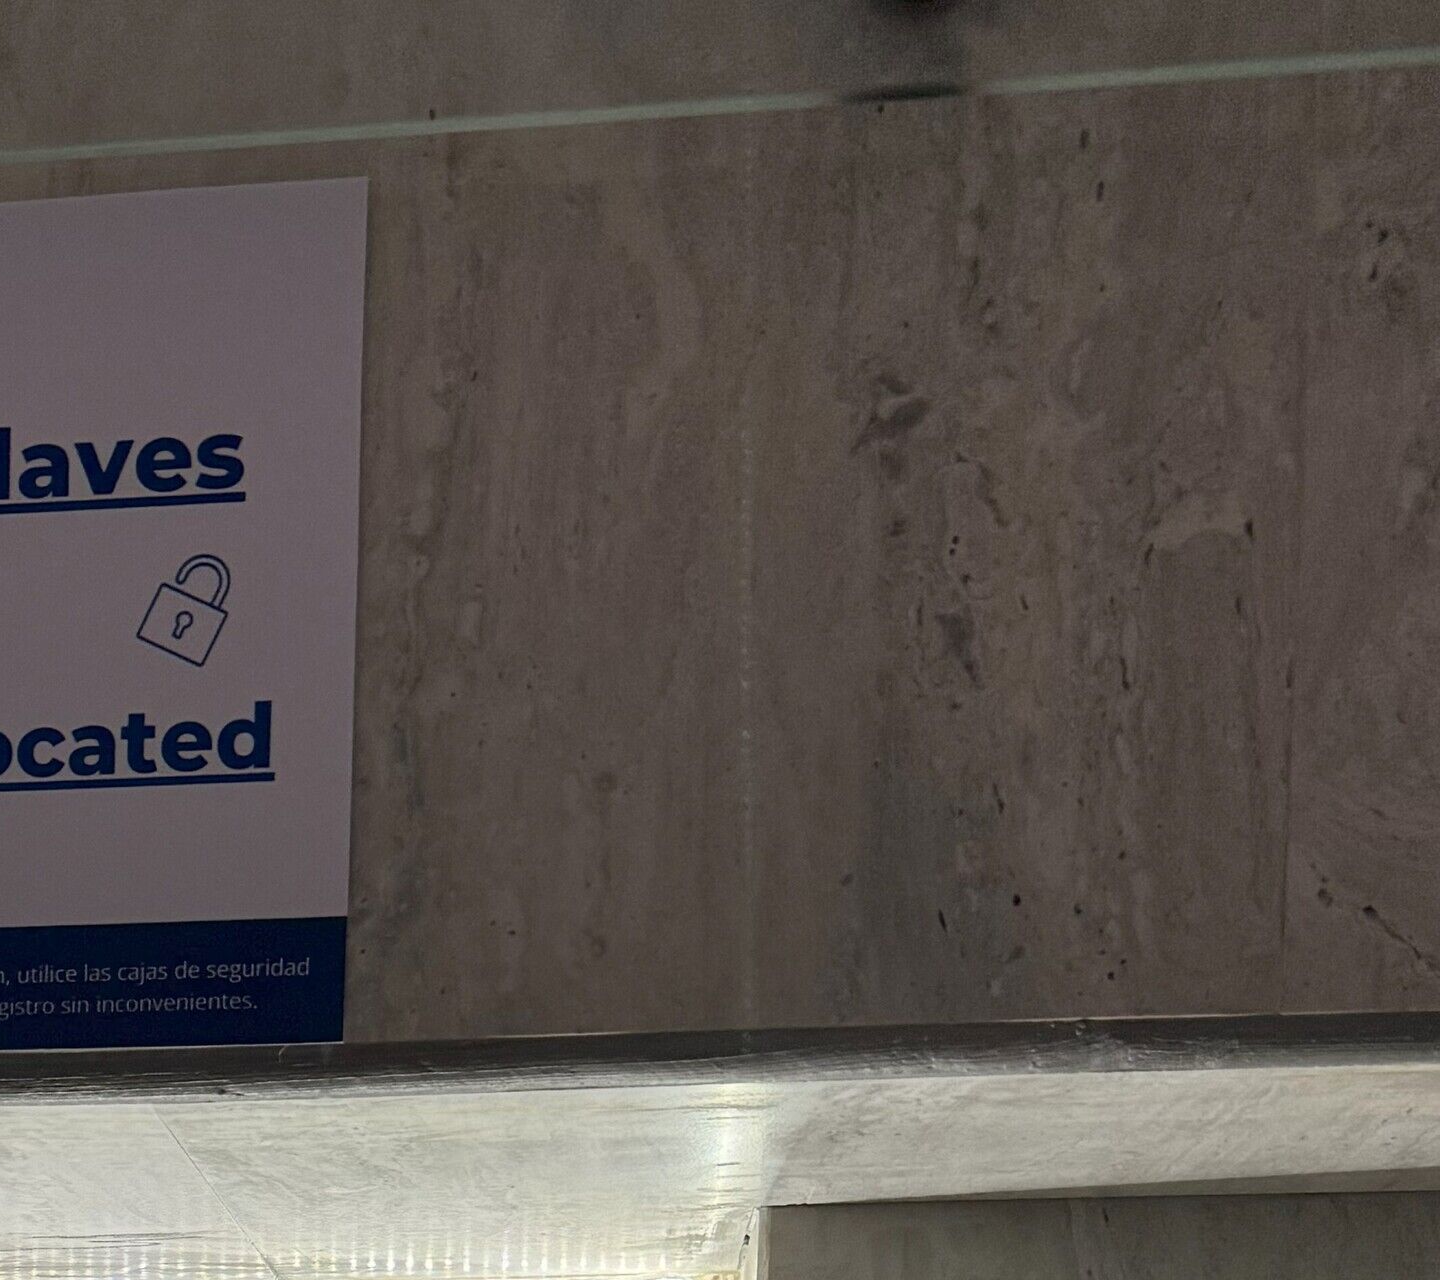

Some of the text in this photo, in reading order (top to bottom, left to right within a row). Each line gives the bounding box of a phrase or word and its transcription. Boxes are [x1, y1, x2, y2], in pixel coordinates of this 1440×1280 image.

[18, 964, 77, 984] utilice
[84, 963, 111, 982] las
[117, 962, 168, 985] cajas
[175, 960, 200, 980] de
[206, 957, 310, 983] seguridad
[60, 997, 90, 1015] sin
[96, 993, 258, 1014] inconvenientes.
